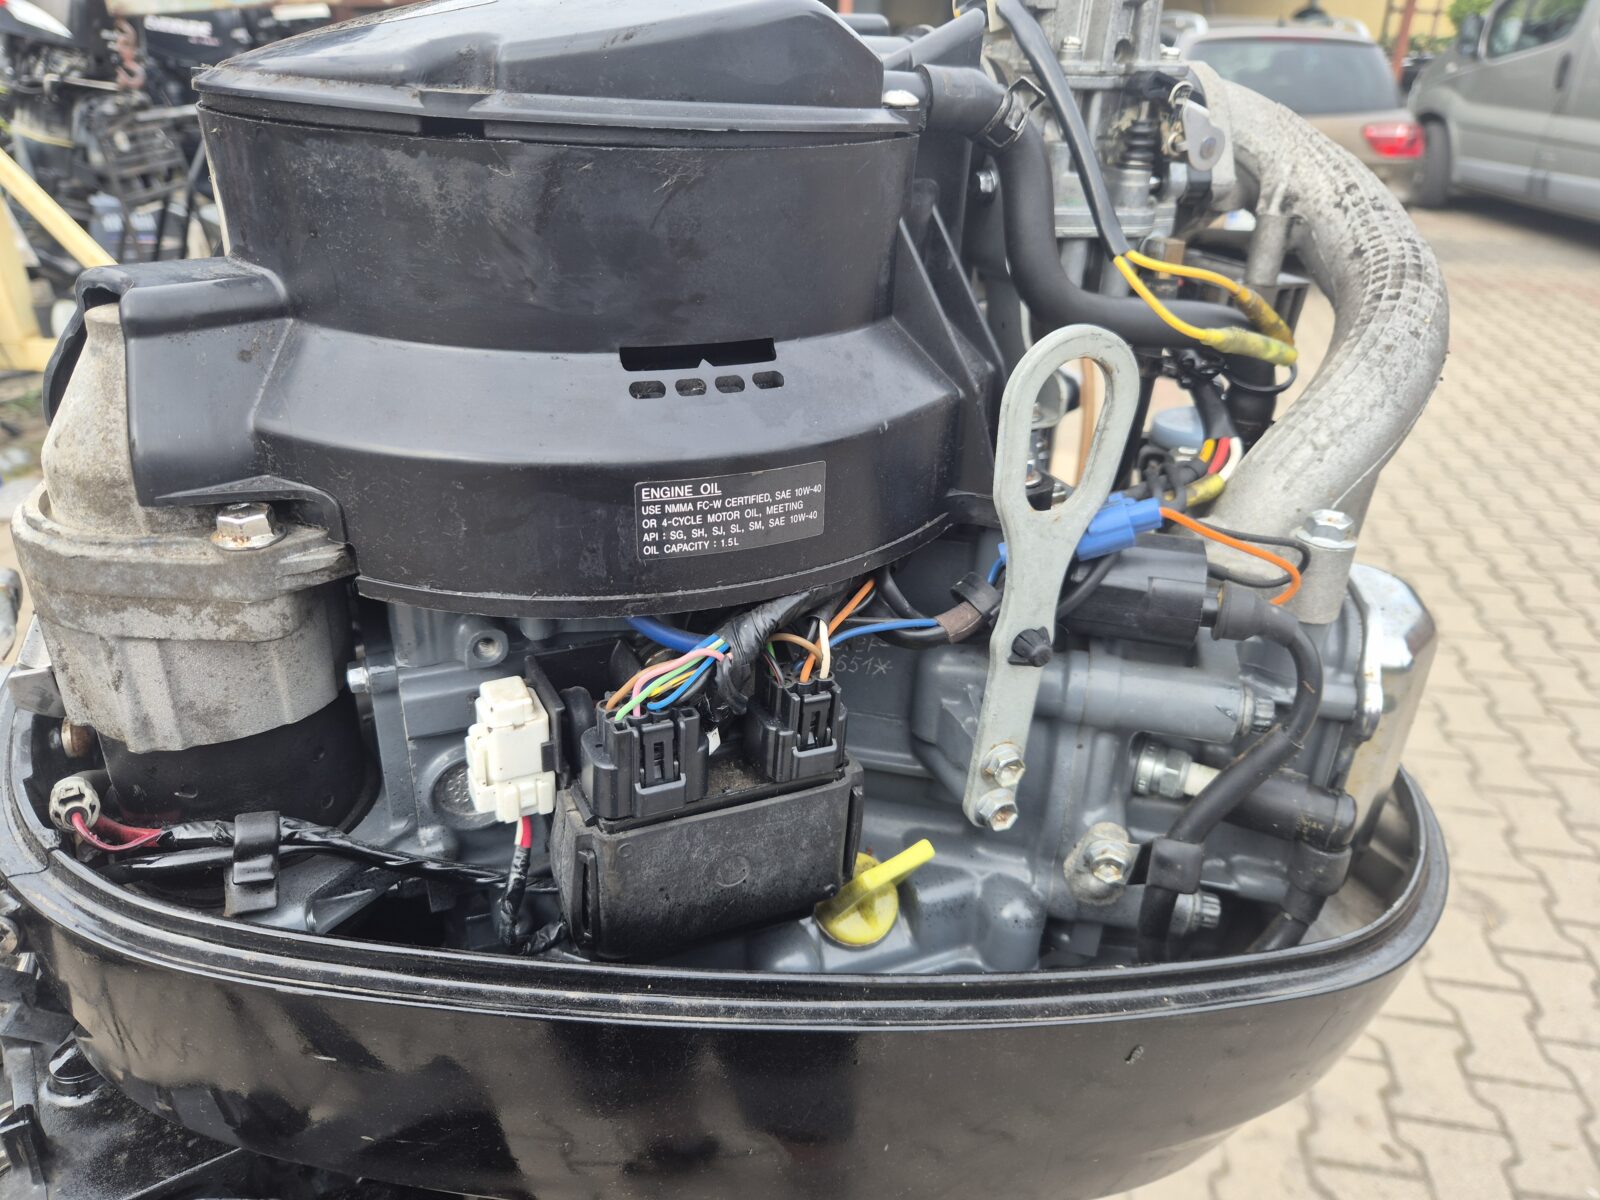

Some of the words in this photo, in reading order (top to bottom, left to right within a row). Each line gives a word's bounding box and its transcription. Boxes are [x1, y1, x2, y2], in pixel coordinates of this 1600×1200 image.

[642, 485, 693, 499] ENGINE
[700, 483, 722, 495] OIL
[642, 505, 661, 515] USE
[665, 501, 694, 513] NMMA
[697, 500, 722, 510] FC-W
[725, 493, 772, 507] CERTIFIED,
[775, 489, 791, 500] SAE
[795, 484, 821, 497] 10W-40
[642, 519, 657, 529] OR
[662, 514, 702, 527] 4-CYCLE
[707, 511, 740, 523] MOTOR
[745, 508, 762, 518] OIL,
[766, 501, 803, 515] MEETING
[643, 532, 658, 542] API
[670, 530, 686, 540] SG,
[692, 529, 707, 538] SH,
[712, 526, 725, 536] SJ,
[730, 524, 744, 533] SL,
[749, 522, 764, 530] SM,
[769, 518, 785, 527] SAE
[790, 511, 817, 523] 10W-40
[643, 545, 658, 555] OIL
[664, 541, 709, 553] CAPACITY
[721, 538, 739, 547] 1.5L
